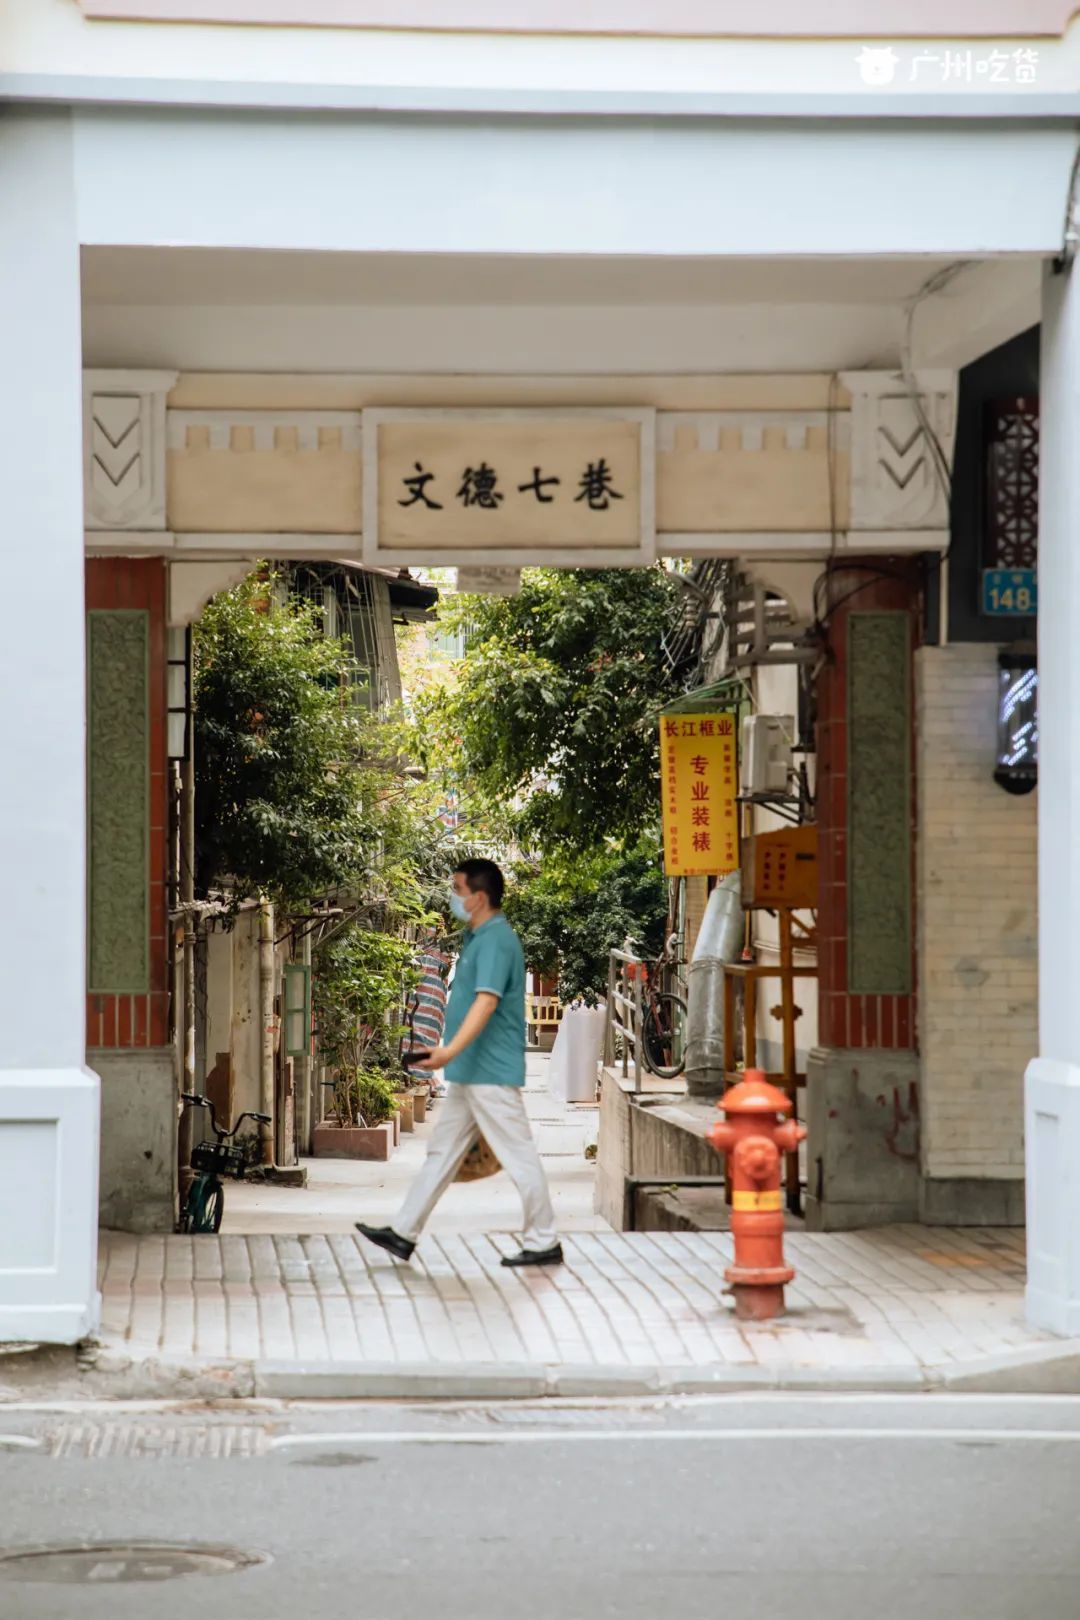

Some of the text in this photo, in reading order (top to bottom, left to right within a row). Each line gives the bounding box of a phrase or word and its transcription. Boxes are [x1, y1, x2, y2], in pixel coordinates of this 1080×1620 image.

[398, 458, 624, 510] 文德七巷
[664, 720, 733, 737] 长江框业
[690, 755, 711, 852] 专业装裱
